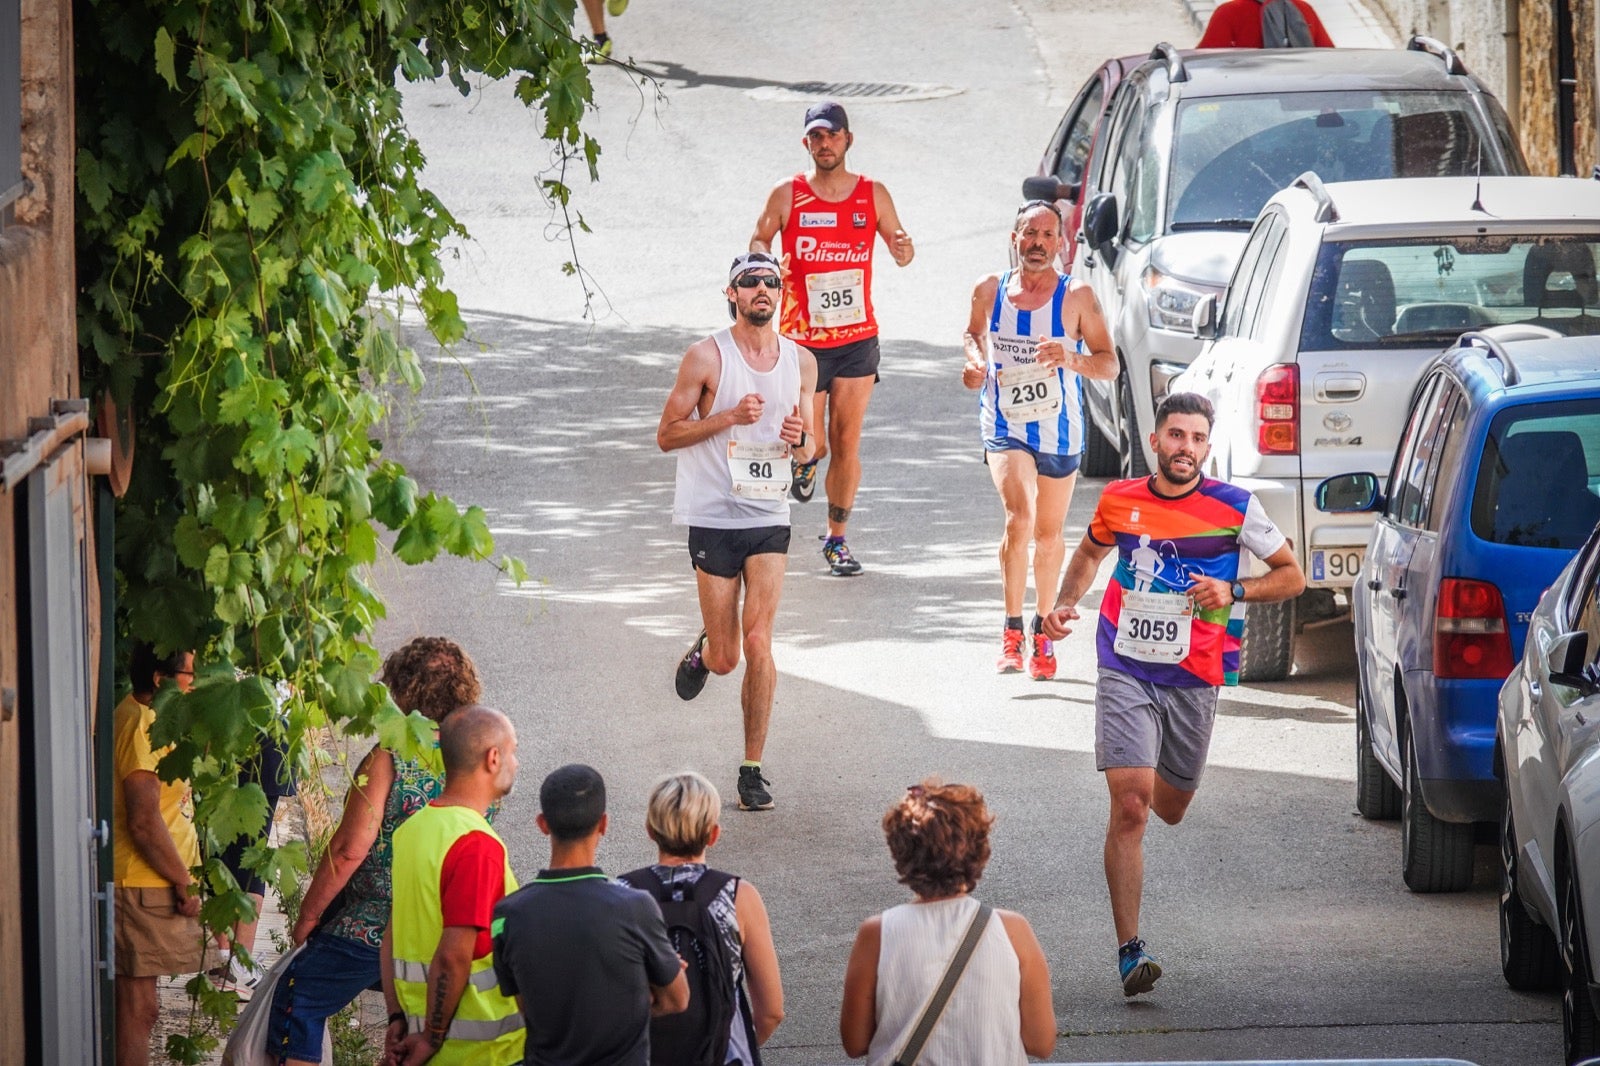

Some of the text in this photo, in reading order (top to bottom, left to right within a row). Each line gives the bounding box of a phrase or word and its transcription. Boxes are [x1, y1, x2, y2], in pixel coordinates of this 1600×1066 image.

[795, 235, 869, 262] Polisalud
[821, 289, 853, 309] 395
[1011, 382, 1048, 405] 230
[749, 461, 773, 479] 80
[1329, 552, 1365, 577] 90
[1128, 617, 1178, 642] 3059
